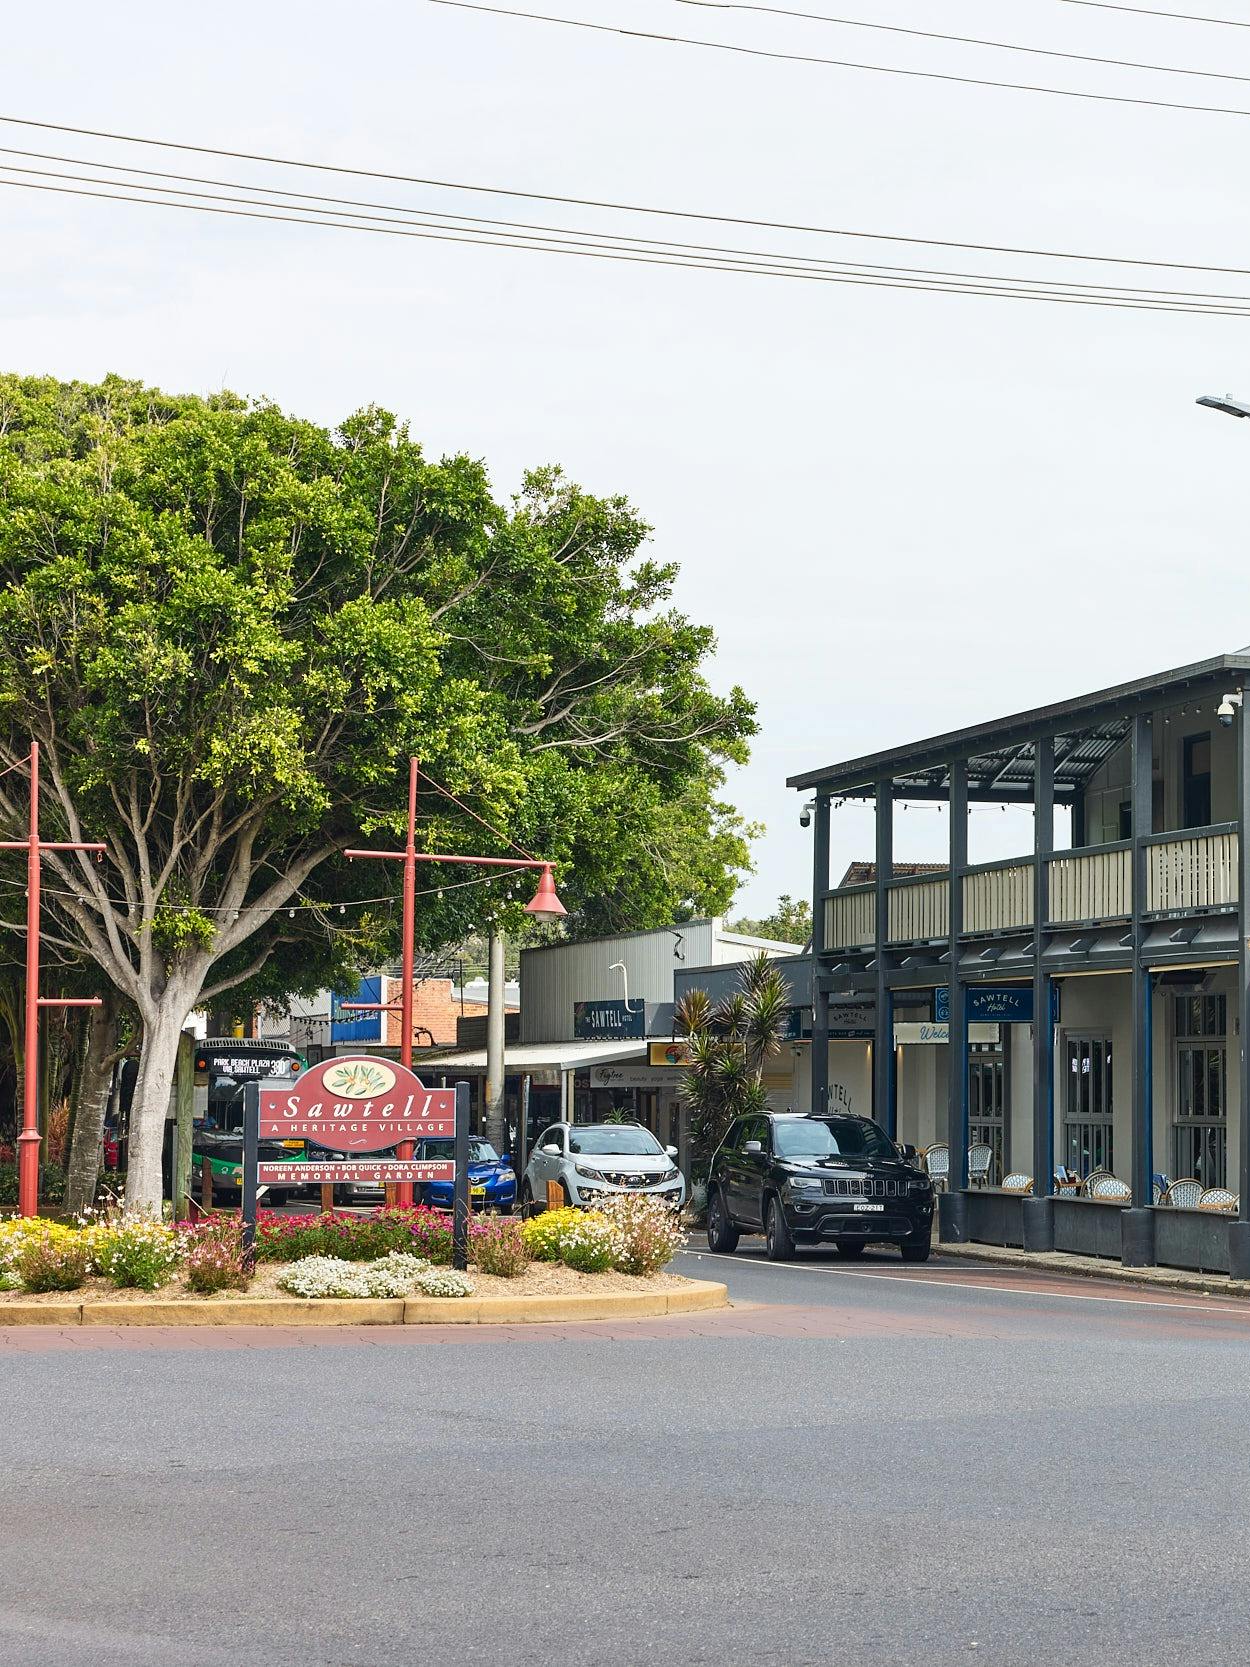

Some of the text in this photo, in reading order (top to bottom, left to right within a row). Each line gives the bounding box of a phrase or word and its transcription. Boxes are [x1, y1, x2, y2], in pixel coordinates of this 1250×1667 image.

[973, 994, 1020, 1007] SAWTELL
[986, 1002, 1006, 1013] Hotel
[591, 1009, 622, 1028] SAWTELL
[833, 1012, 868, 1022] SAWTELL
[213, 1058, 270, 1068] PARK BEACH PLAZA
[233, 1065, 261, 1074] SAWTELL
[283, 1095, 433, 1118] Sawtell
[271, 1123, 445, 1132] A HERITAGE VILLAGE
[294, 1164, 336, 1172] ANDERSON
[277, 1171, 434, 1181] MEMORIAL GARDEN
